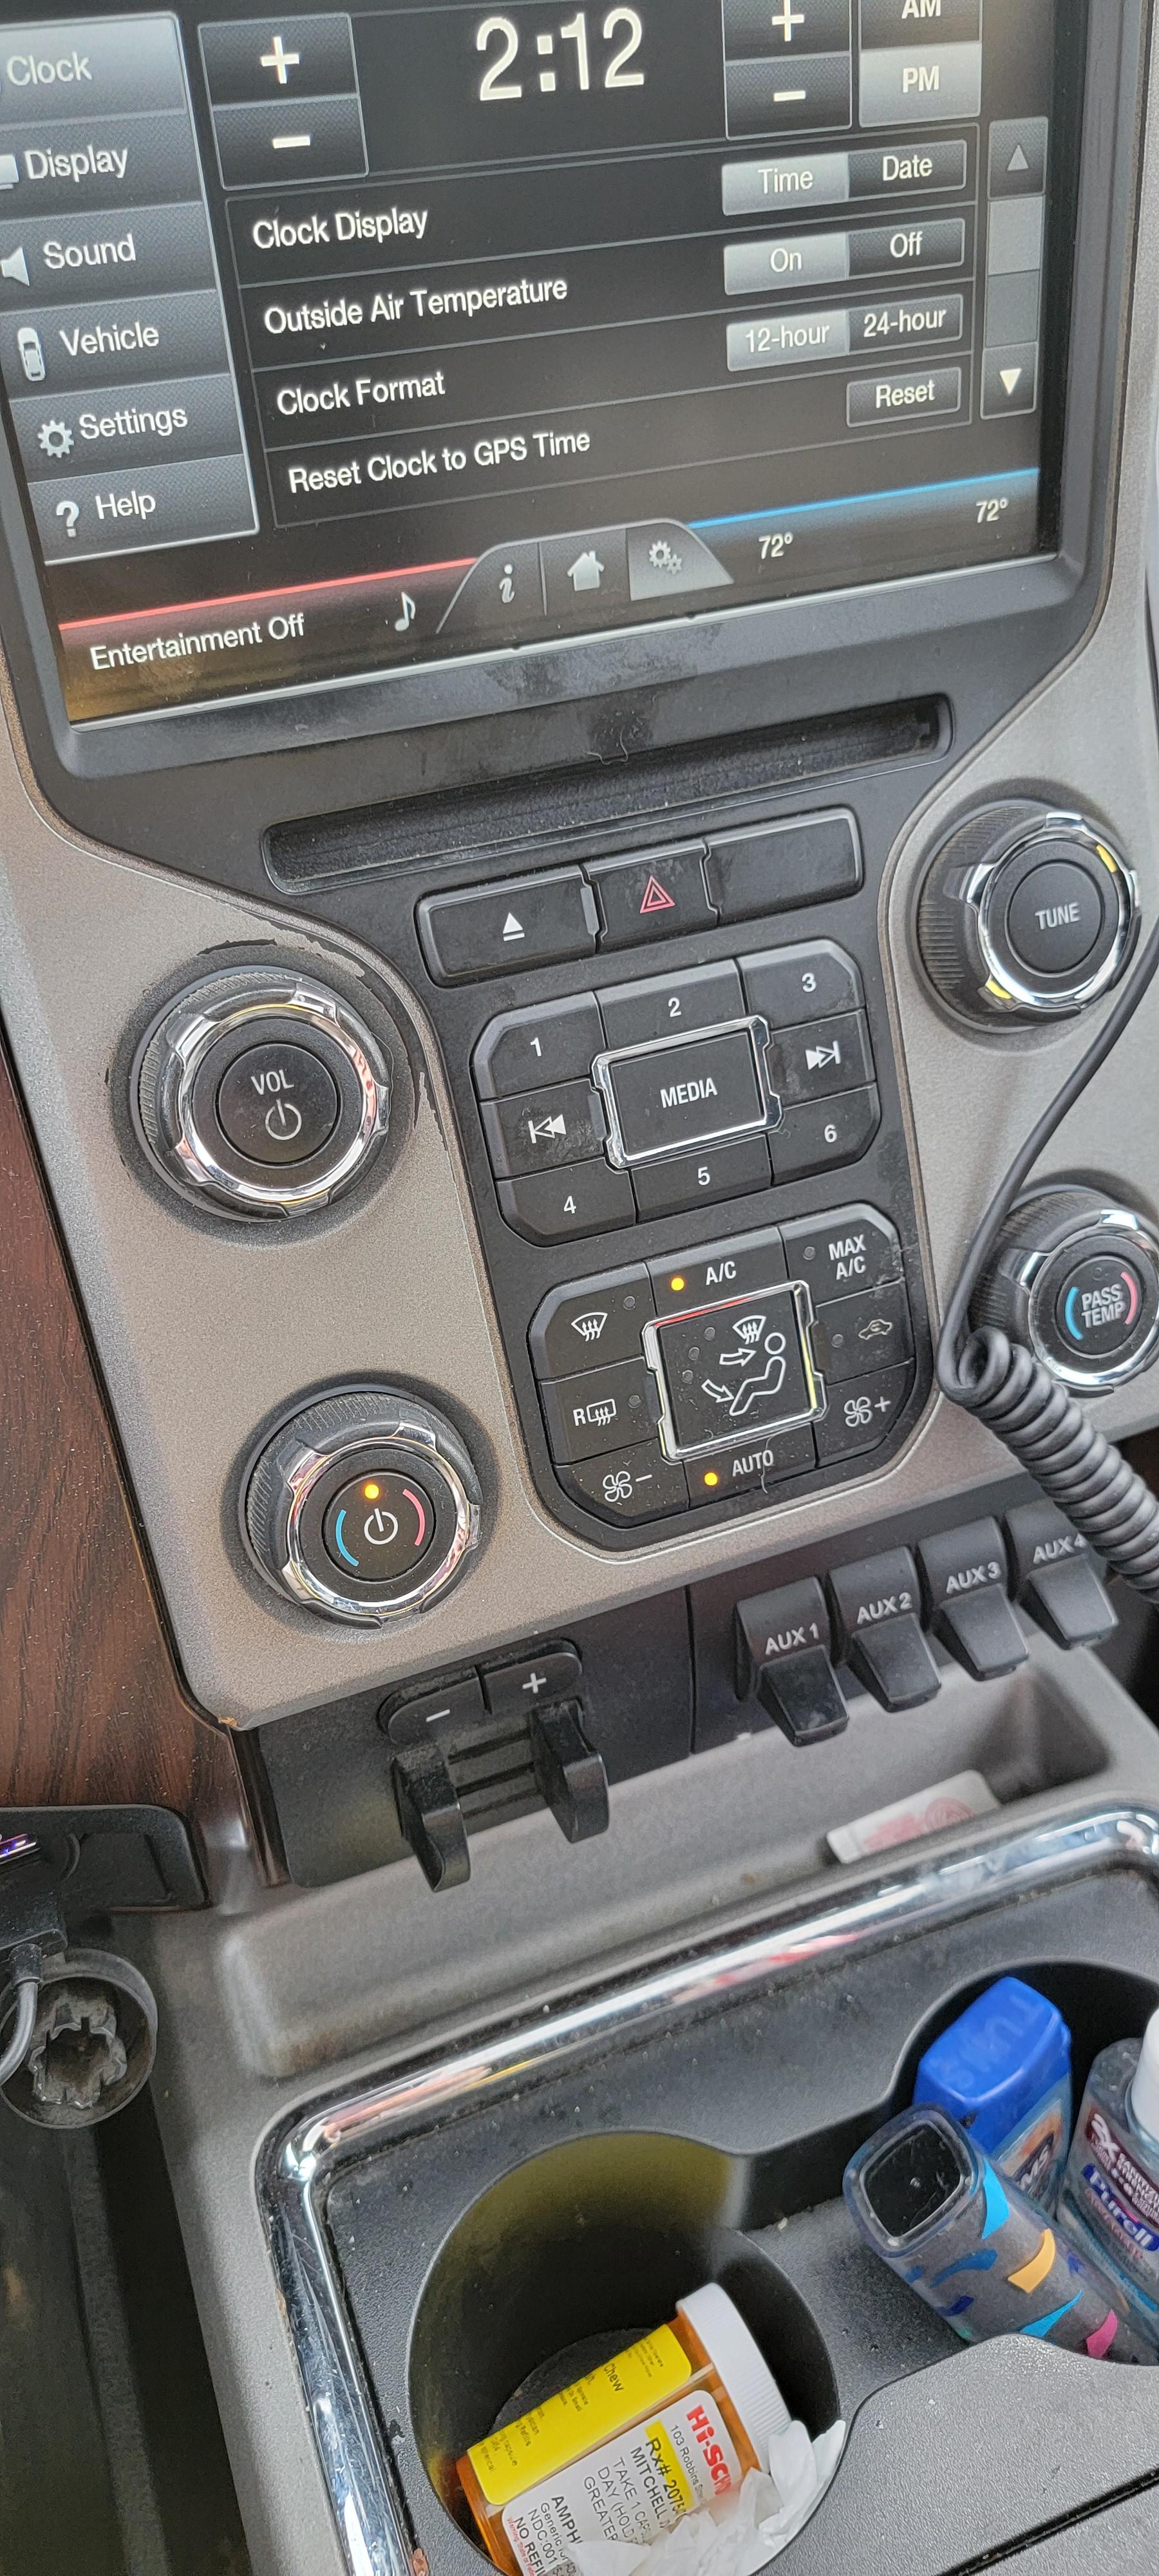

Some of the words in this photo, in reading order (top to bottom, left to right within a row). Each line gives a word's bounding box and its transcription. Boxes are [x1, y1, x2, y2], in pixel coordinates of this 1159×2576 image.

[6, 52, 93, 88] Clock
[475, 8, 645, 102] 2:12
[901, 66, 940, 93] PM
[26, 148, 129, 183] Display
[759, 168, 814, 196] Time
[883, 155, 933, 182] Date
[253, 214, 330, 250] Clock
[335, 207, 429, 242] Display
[43, 234, 137, 270] Sound
[770, 249, 802, 273] On
[890, 232, 923, 258] Off
[264, 298, 364, 335] Outside
[370, 293, 405, 323] Air
[410, 278, 569, 323] Temperature
[60, 322, 160, 357] Vehicle
[745, 326, 831, 354] 12-hour
[863, 309, 947, 338] 24-hour
[276, 386, 351, 417] Clock
[357, 372, 446, 406] Format
[875, 380, 936, 408] Reset
[79, 406, 189, 442] Settings
[288, 467, 362, 495] Reset
[368, 455, 438, 482] Clock
[442, 451, 467, 471] to
[474, 439, 529, 468] GPS
[533, 430, 590, 459] Time
[96, 490, 157, 523] Help
[90, 622, 264, 671] Entertainment
[268, 612, 305, 640] Off
[1034, 902, 1082, 928] TUNE
[801, 972, 817, 992] 3
[668, 998, 682, 1017] 2
[530, 1037, 543, 1057] 1
[250, 1069, 295, 1095] VOL
[659, 1078, 718, 1108] MEDIA
[824, 1124, 838, 1143] 6
[697, 1167, 711, 1186] 5
[563, 1195, 578, 1215] 4
[828, 1235, 867, 1260] MAX
[705, 1260, 737, 1285] A/C
[835, 1260, 867, 1280] A/C
[1081, 1283, 1123, 1309] PASS
[1081, 1302, 1126, 1329] TEMP
[731, 1448, 774, 1477] AUTO
[1033, 1535, 1075, 1564] AUX
[1074, 1533, 1088, 1549] 4
[946, 1569, 986, 1594] AUX
[987, 1562, 1002, 1580] 3
[856, 1598, 898, 1624] AUX
[898, 1592, 913, 1610] 2
[764, 1631, 807, 1655] AUX
[809, 1623, 820, 1640] 1
[603, 2362, 624, 2391] Chew
[645, 2436, 672, 2477] Rx#
[669, 2423, 685, 2447] 103
[679, 2446, 699, 2485] Robbins
[598, 2466, 619, 2498] DAY
[613, 2456, 637, 2500] TAKE
[630, 2501, 641, 2509] 1
[630, 2446, 667, 2520] MITCHELL
[513, 2516, 530, 2540] NO
[540, 2501, 563, 2546] Generic
